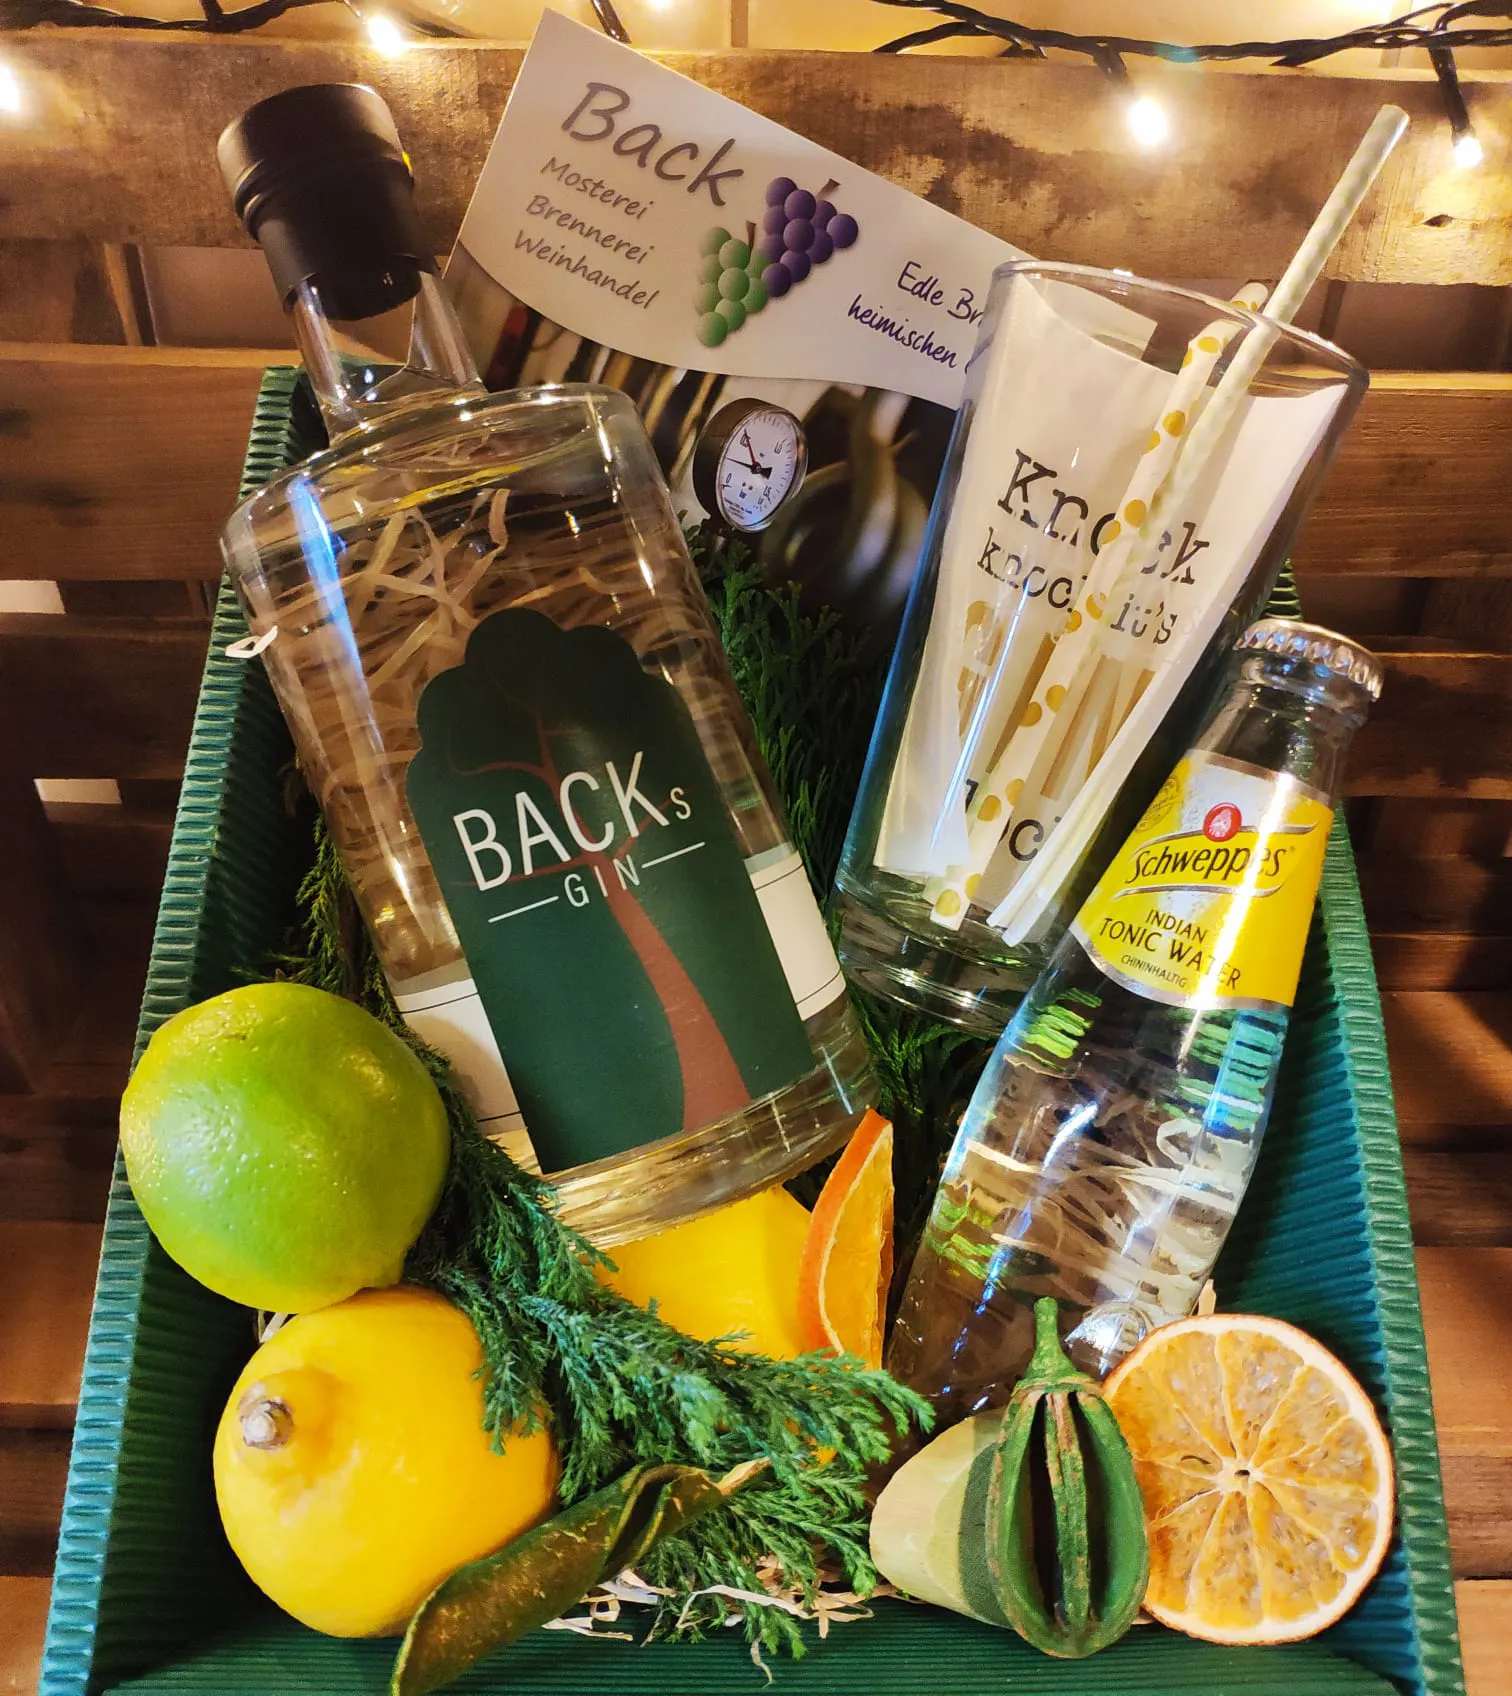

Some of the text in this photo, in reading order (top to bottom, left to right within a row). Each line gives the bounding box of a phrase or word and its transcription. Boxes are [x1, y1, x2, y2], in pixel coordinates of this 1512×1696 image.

[561, 81, 744, 207] Back
[540, 156, 654, 220] Mosterei
[526, 195, 655, 264] Brennerei
[514, 230, 660, 309] Weinhandel
[897, 260, 985, 328] Edle Br
[848, 294, 957, 369] heimischen
[977, 526, 1088, 614] knoc
[564, 854, 640, 907] GIN
[1125, 846, 1286, 884] Schweppes
[1099, 917, 1162, 952] TONIC
[1145, 909, 1209, 944] INDIAN
[1121, 954, 1188, 988] CHININHALTIG
